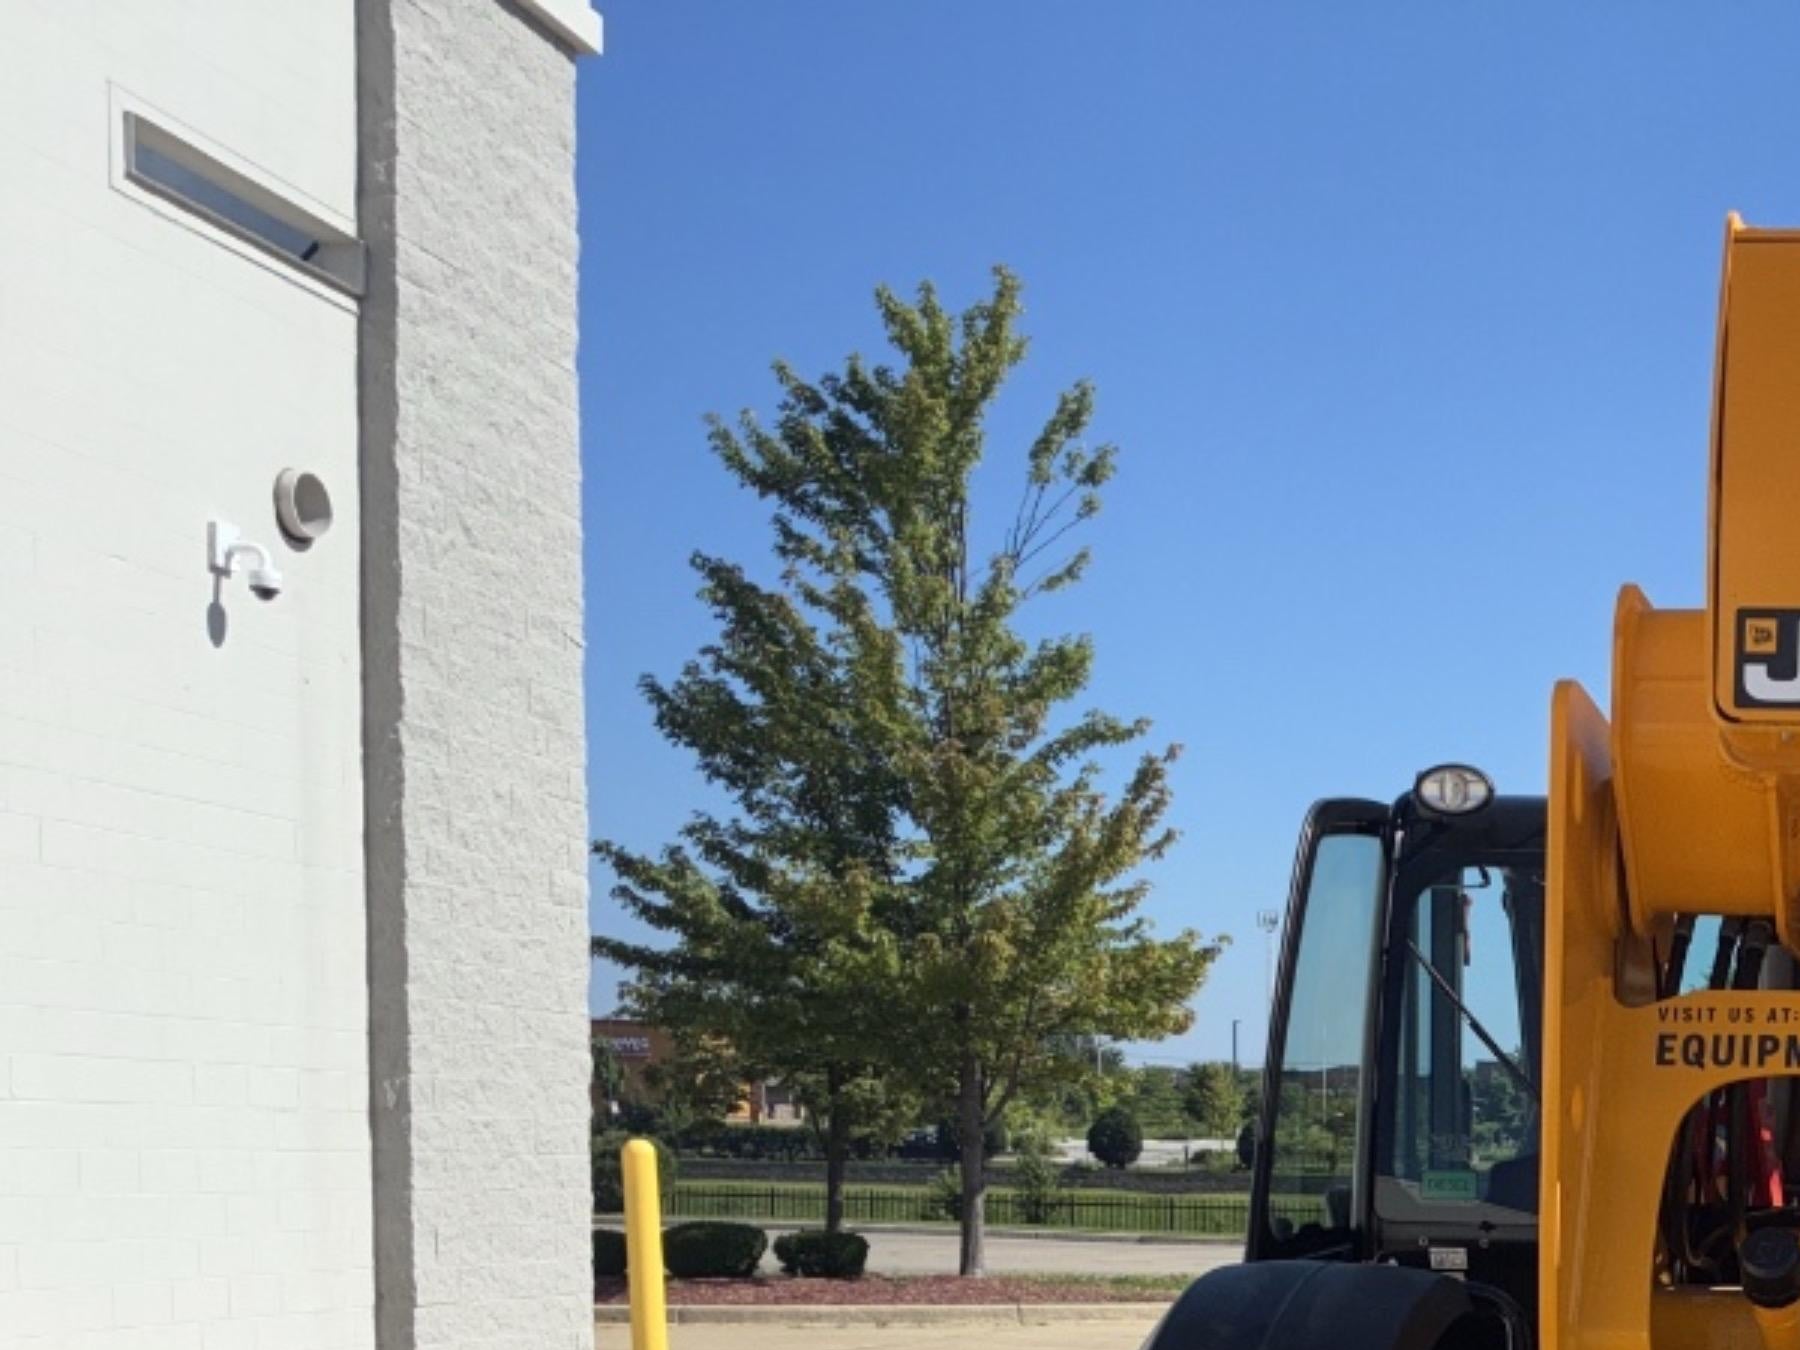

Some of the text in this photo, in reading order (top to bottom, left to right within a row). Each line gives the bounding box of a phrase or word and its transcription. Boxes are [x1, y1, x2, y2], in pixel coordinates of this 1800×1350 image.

[1657, 1006, 1800, 1024] VISIT US AT:
